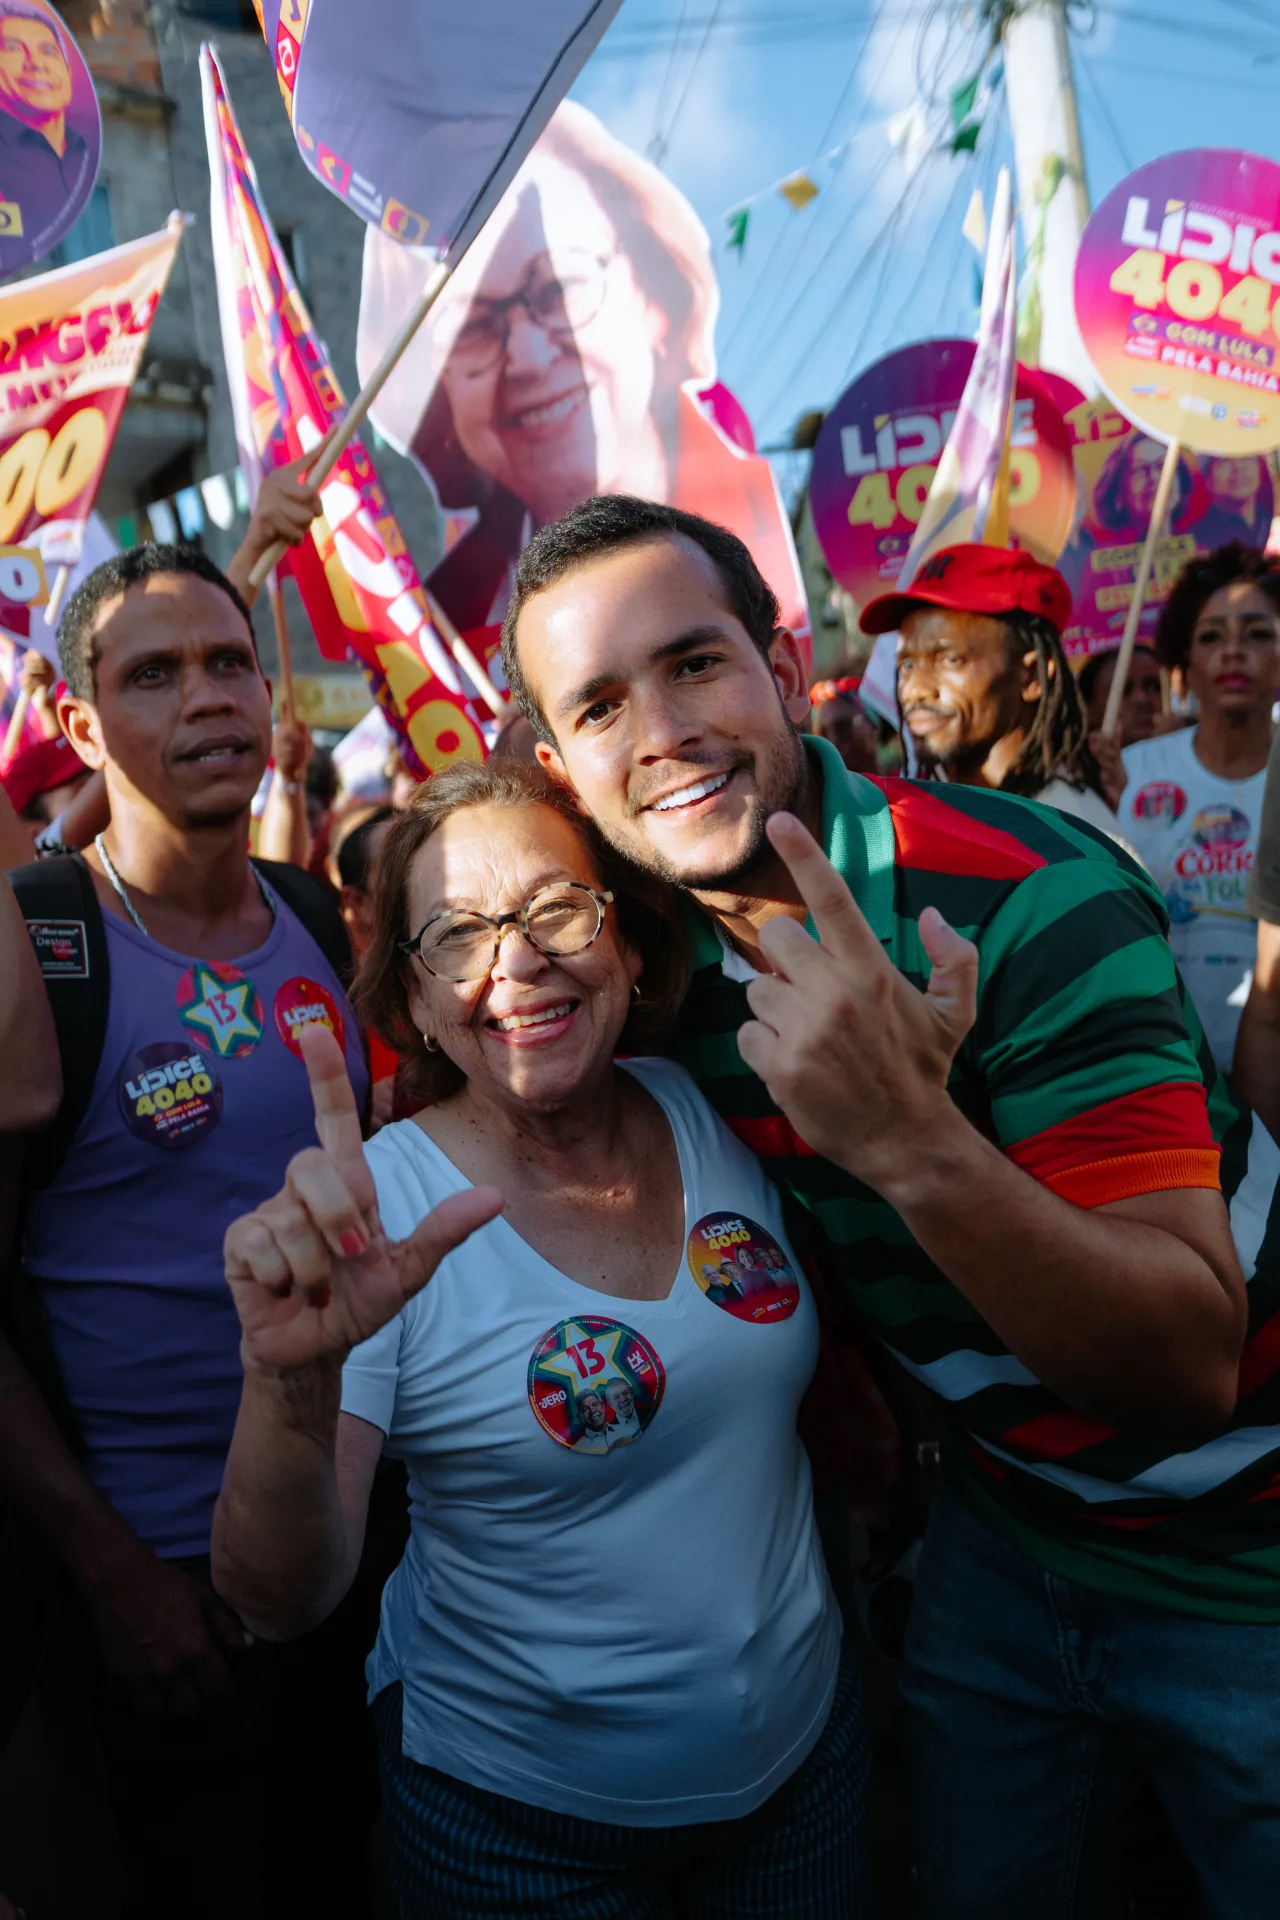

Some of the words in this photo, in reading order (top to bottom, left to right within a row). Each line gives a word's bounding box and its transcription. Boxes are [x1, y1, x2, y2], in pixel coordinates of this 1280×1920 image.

[1110, 248, 1280, 340] 404
[1219, 334, 1268, 364] LULA
[1162, 346, 1212, 373] PELA
[1217, 360, 1280, 391] BAHIA
[848, 449, 1041, 530] 400
[36, 937, 72, 949] Design
[205, 992, 236, 1026] 13
[136, 1072, 212, 1117] 4040
[183, 1099, 202, 1110] LULA
[168, 1113, 187, 1125] PELA
[187, 1103, 210, 1117] BAHIA
[709, 1229, 751, 1250] 4040
[565, 1337, 606, 1379] 13
